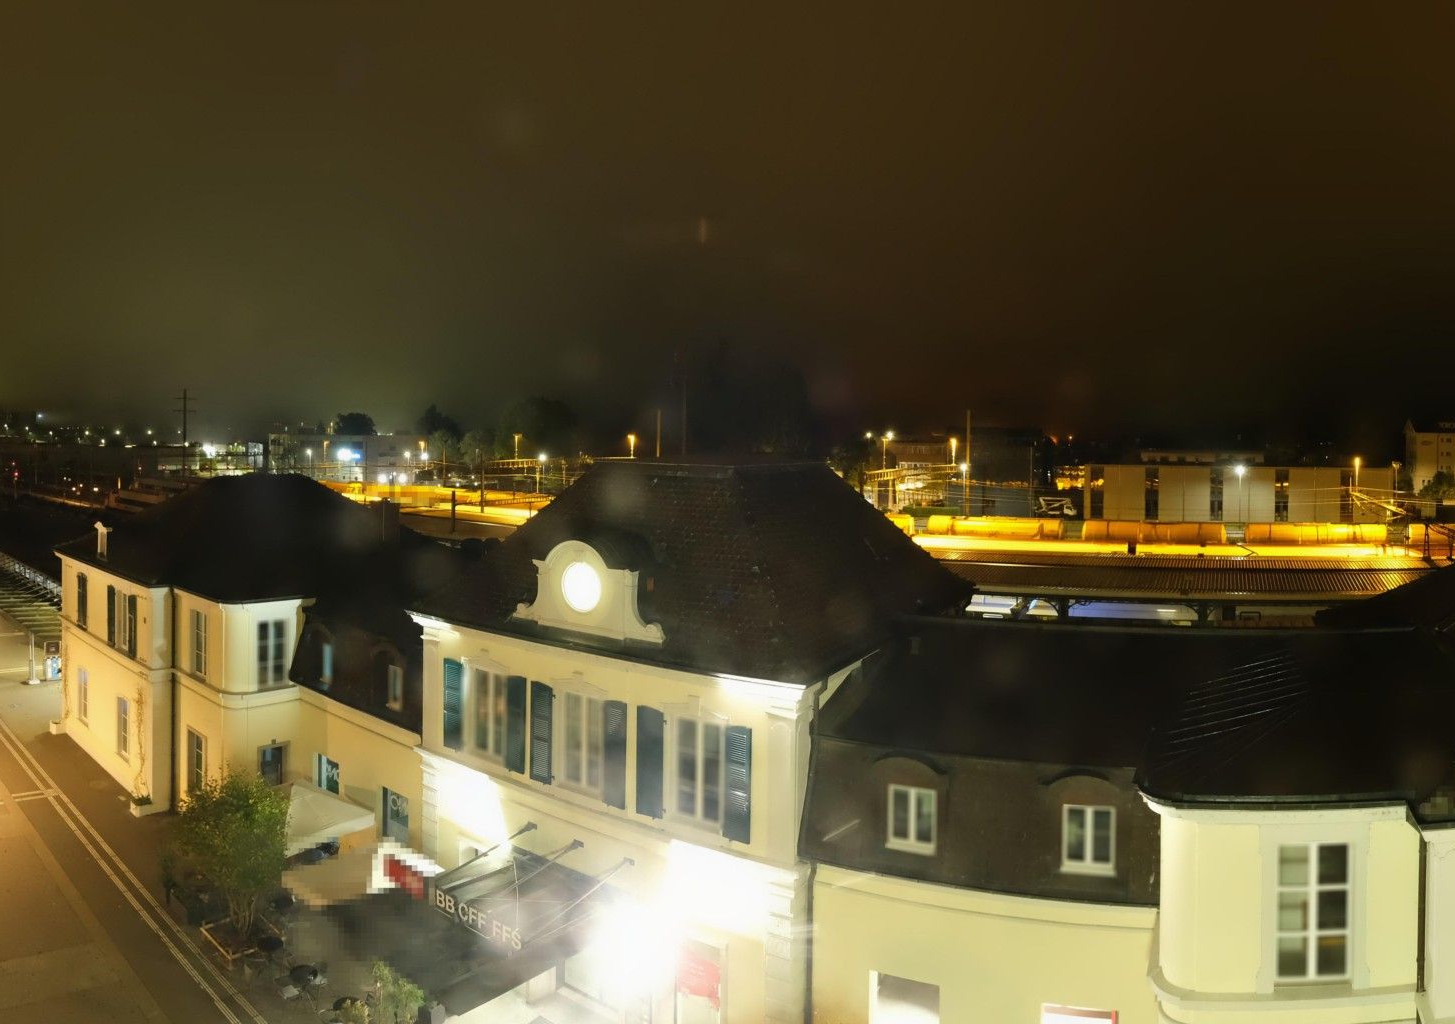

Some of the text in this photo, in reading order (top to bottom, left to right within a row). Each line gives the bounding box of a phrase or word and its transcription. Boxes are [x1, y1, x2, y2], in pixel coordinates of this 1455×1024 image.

[431, 888, 522, 950] BB CFF FFS
